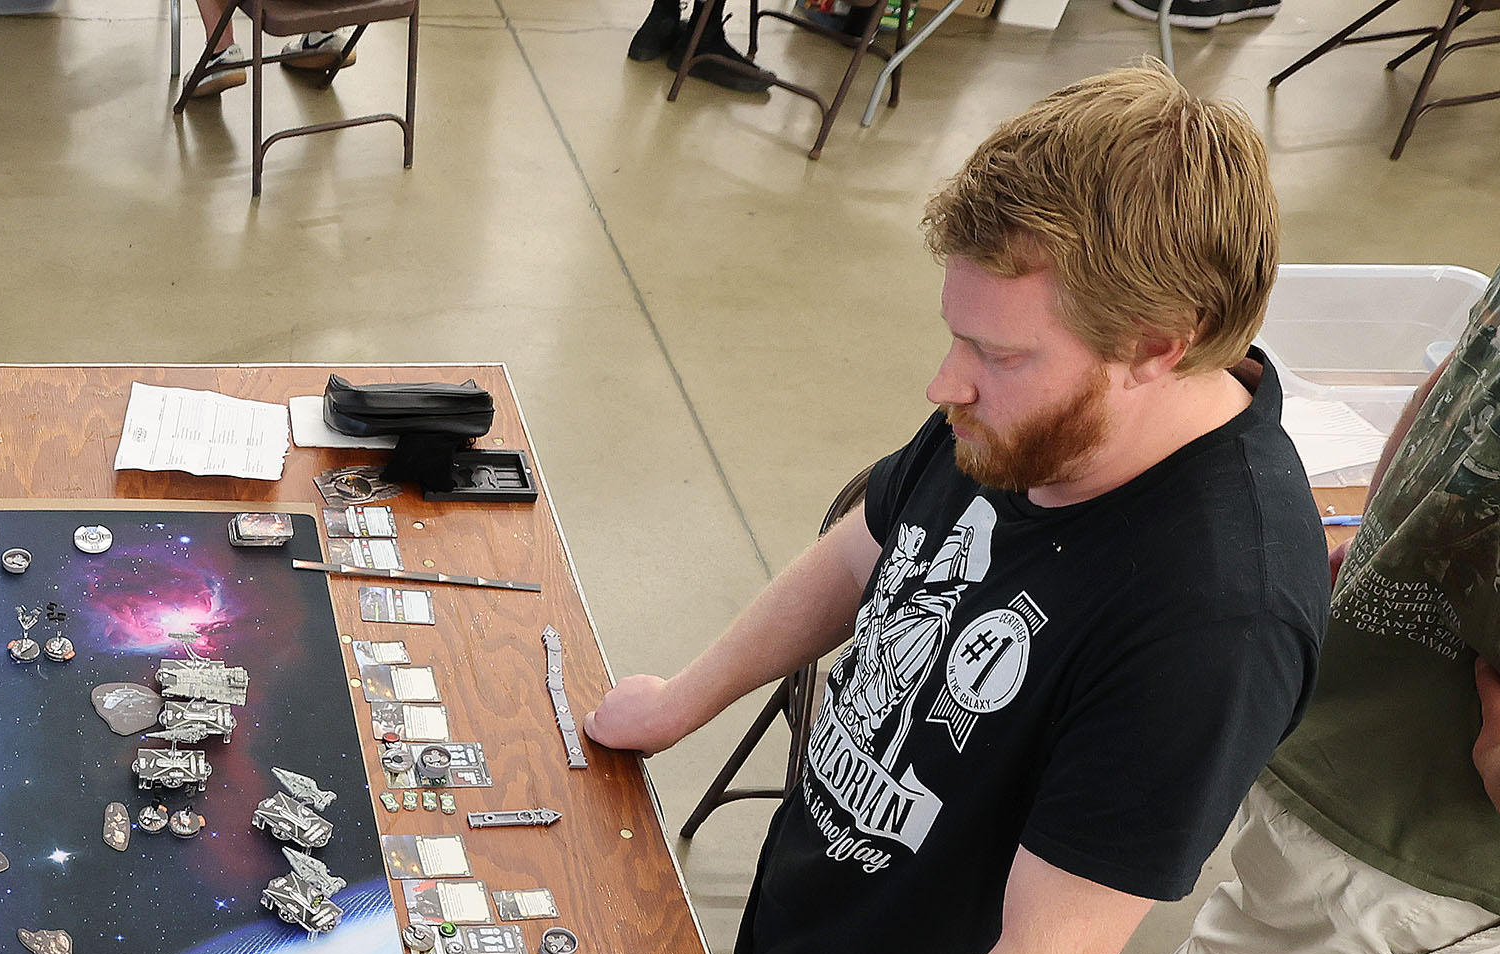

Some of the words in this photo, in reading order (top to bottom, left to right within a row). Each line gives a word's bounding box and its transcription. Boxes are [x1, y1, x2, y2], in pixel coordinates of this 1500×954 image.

[1365, 565, 1428, 591] ITHUANIA
[1348, 595, 1391, 617] ITALY
[999, 612, 1027, 643] CERTIFIED
[1352, 609, 1417, 630] POLAND
[1356, 621, 1386, 635] USA
[1407, 631, 1458, 660] CANADA
[948, 664, 956, 676] IN
[960, 629, 1016, 698] #1
[950, 676, 963, 696] THE
[959, 692, 991, 710] GALAXY
[825, 826, 892, 873] Way
